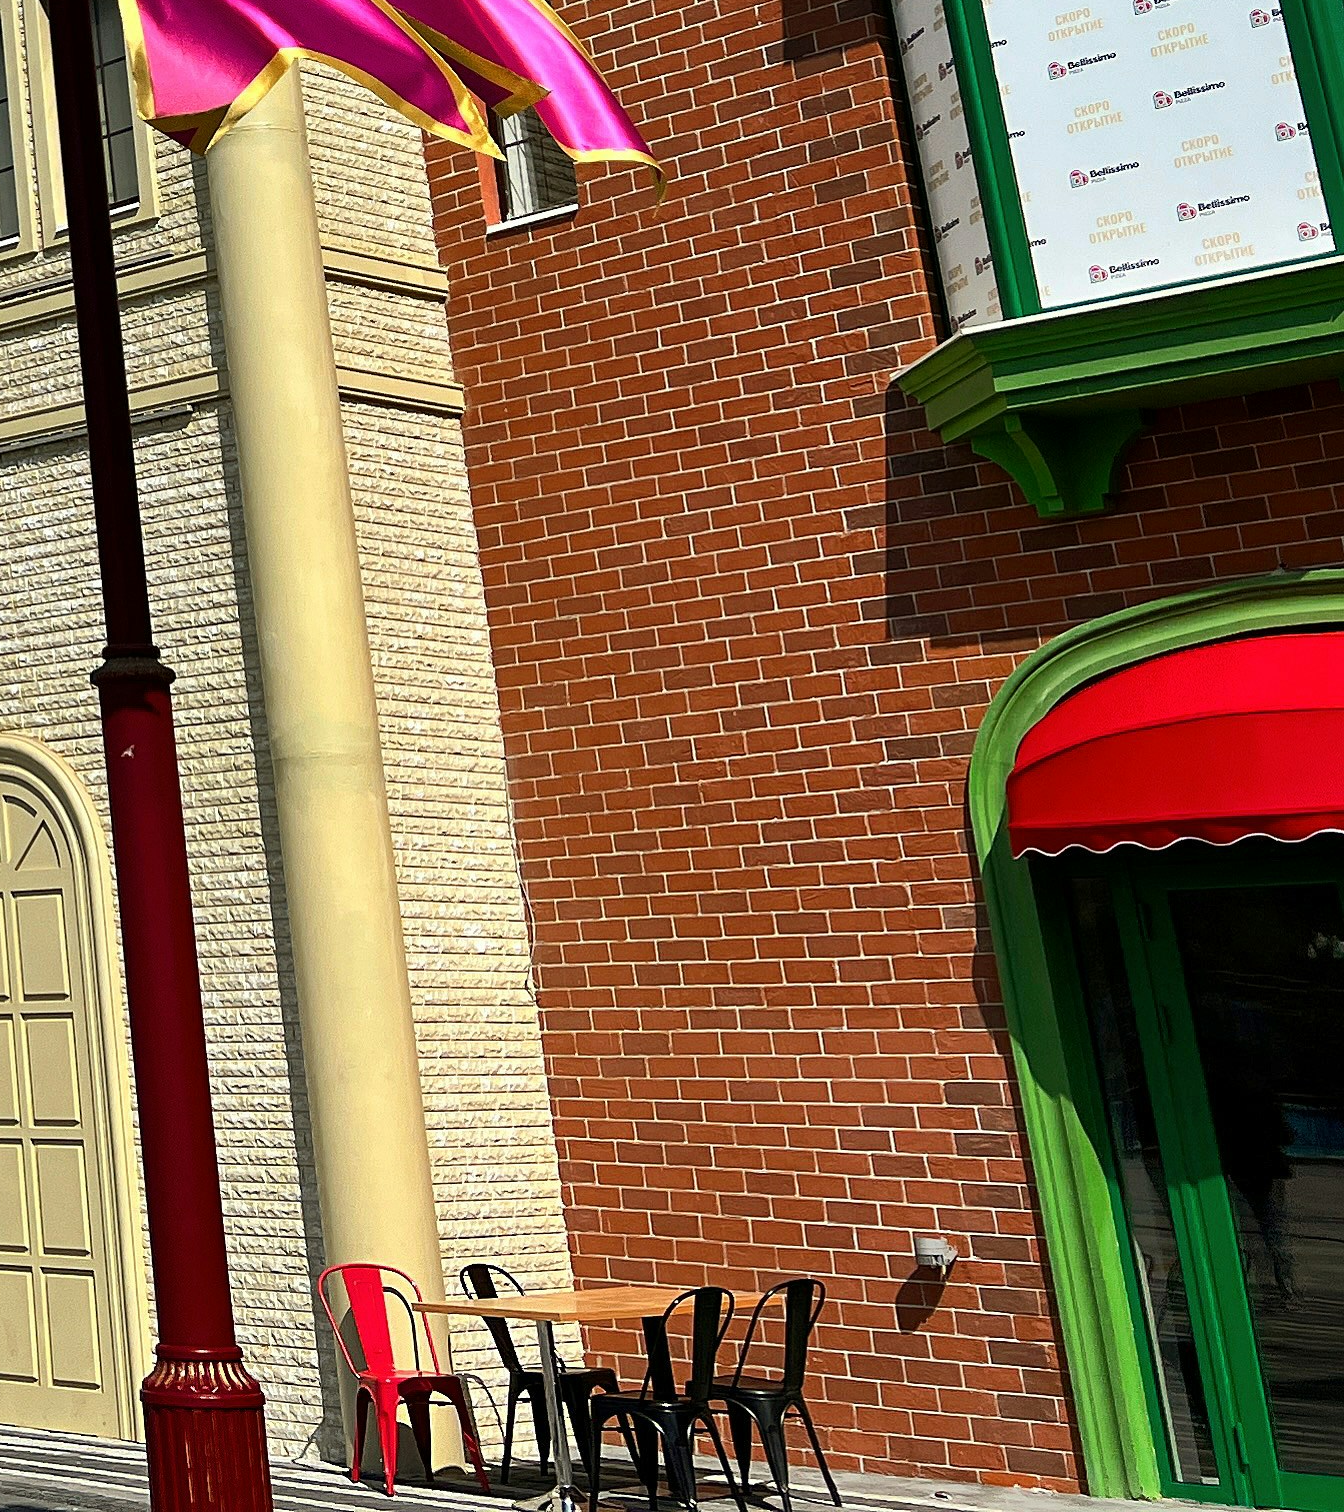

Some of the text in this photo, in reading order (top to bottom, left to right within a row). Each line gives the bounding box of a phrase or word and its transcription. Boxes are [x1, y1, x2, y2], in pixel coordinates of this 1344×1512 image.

[1055, 8, 1092, 26] СКОРО
[1048, 18, 1105, 43] ОТКРЫТИЕ
[1157, 22, 1196, 42] СКОРО
[1150, 33, 1209, 58] ОТКРЫТИЕ
[1067, 51, 1117, 70] Bellissimo
[1173, 79, 1226, 99] Bellissimo
[1074, 100, 1111, 119] СКОРО
[1066, 111, 1124, 135] ОТКРЫТИЕ
[1181, 134, 1220, 152] СКОРО
[1173, 145, 1235, 169] ОТКРЫТИЕ
[1089, 159, 1140, 179] Bellissimo
[1197, 193, 1251, 212] Bellissimo
[1096, 210, 1134, 228] СКОРО
[1088, 222, 1148, 245] ОТКРЫТИЕ
[1201, 231, 1241, 250] СКОРО
[1194, 243, 1256, 267] ОТКРЫТИЕ
[1108, 256, 1160, 275] Bellissimo
